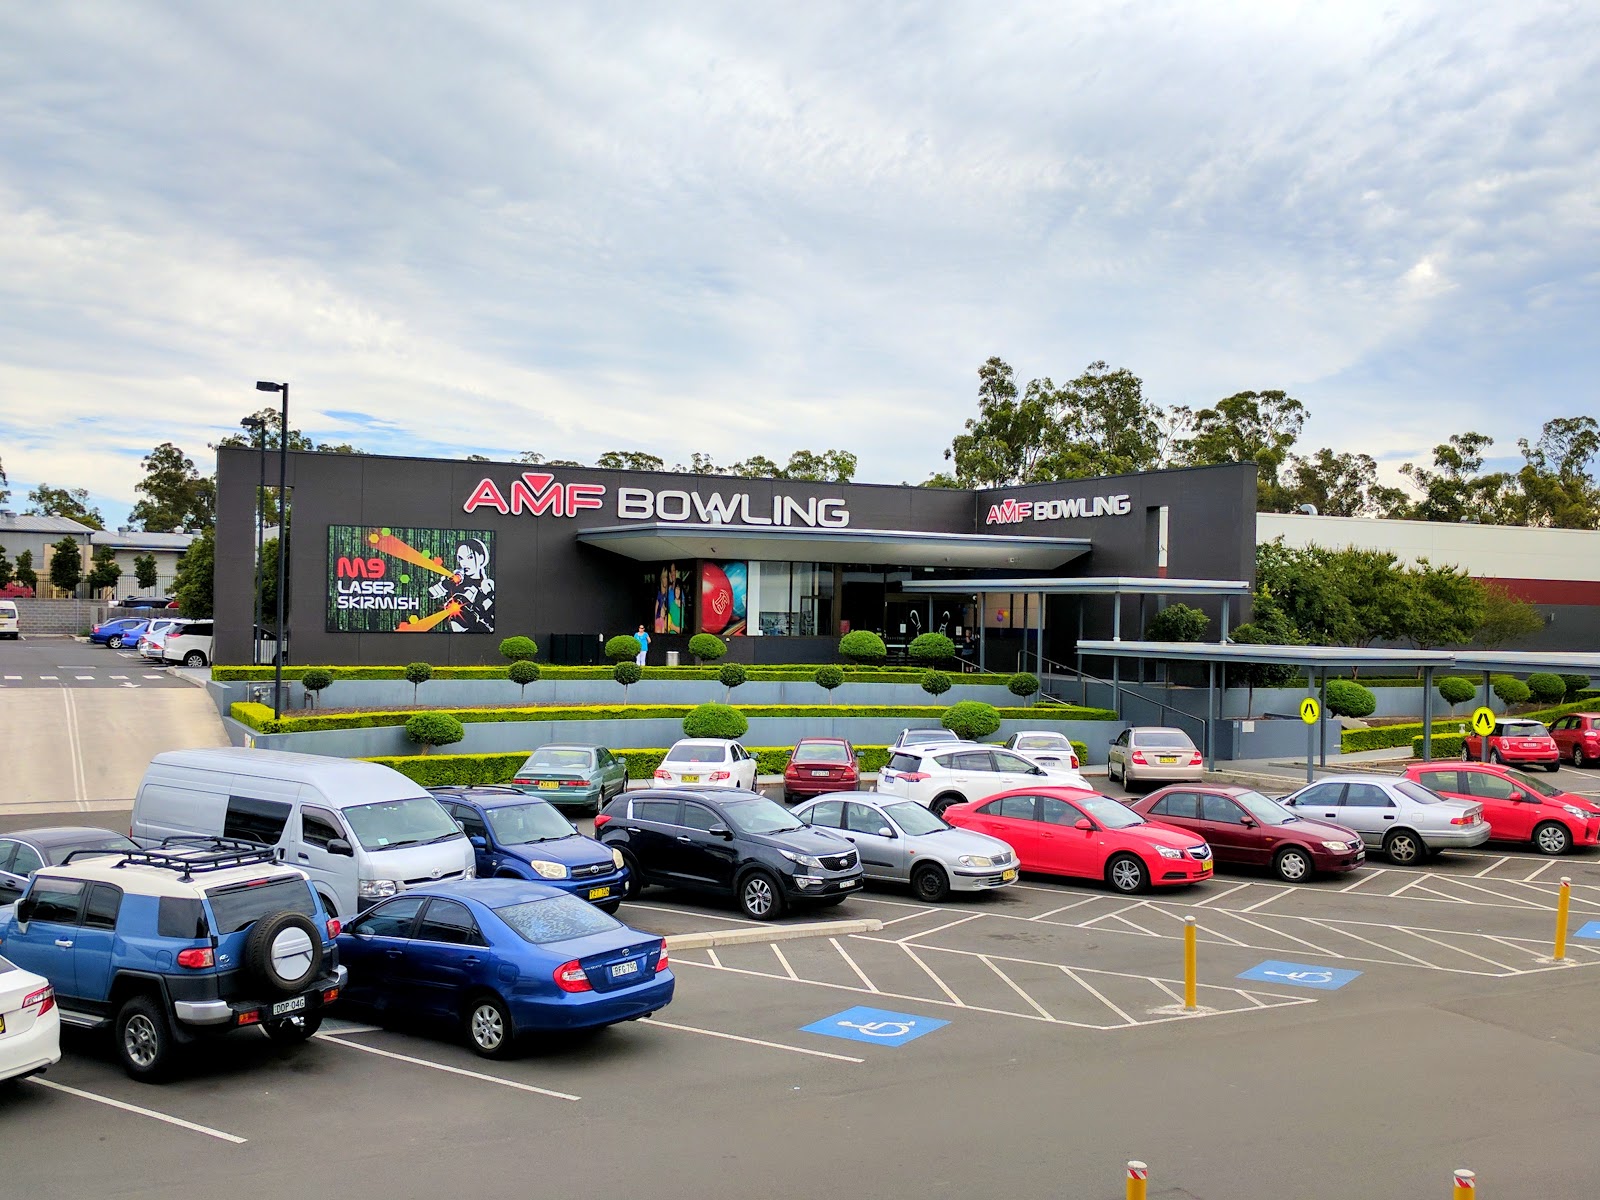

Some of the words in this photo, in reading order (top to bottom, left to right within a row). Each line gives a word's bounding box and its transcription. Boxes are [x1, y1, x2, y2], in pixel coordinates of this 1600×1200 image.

[463, 472, 606, 518] AMF
[617, 487, 851, 528] BOWLING
[986, 498, 1033, 525] AMF
[1033, 494, 1131, 521] BOWLING
[337, 556, 386, 579] M9
[337, 580, 395, 595] LASER
[337, 596, 419, 610] SKIRMISH
